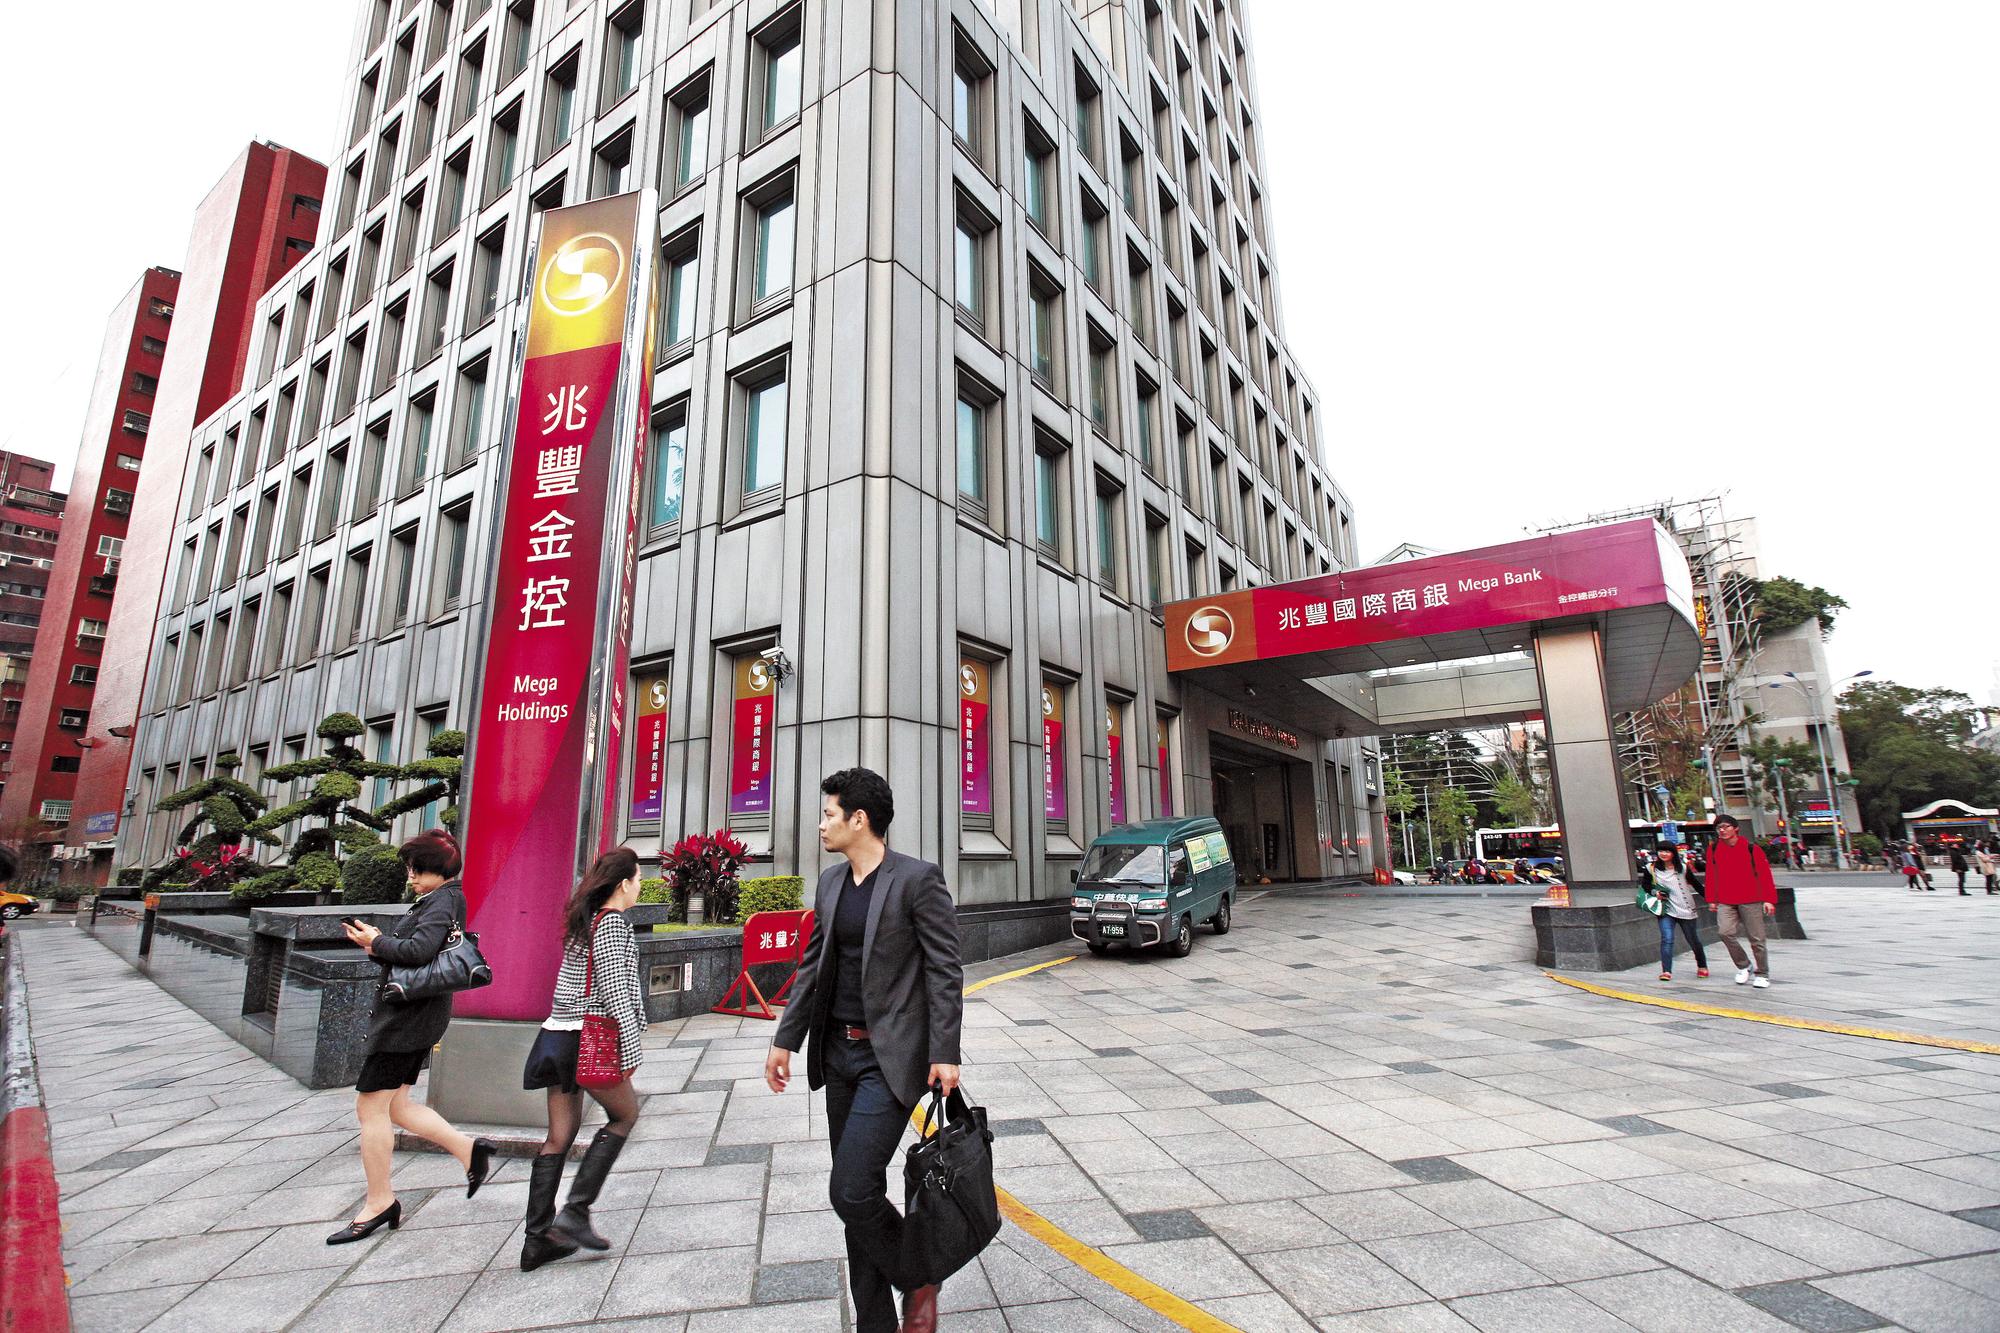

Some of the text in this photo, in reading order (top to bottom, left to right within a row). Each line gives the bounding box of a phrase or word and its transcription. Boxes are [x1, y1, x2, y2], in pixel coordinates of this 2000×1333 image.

[518, 384, 589, 631] 兆豐金控
[1278, 568, 1543, 631] 兆豐國際商銀 Mega Bank
[513, 675, 558, 696] Mega
[498, 702, 568, 723] Holdings
